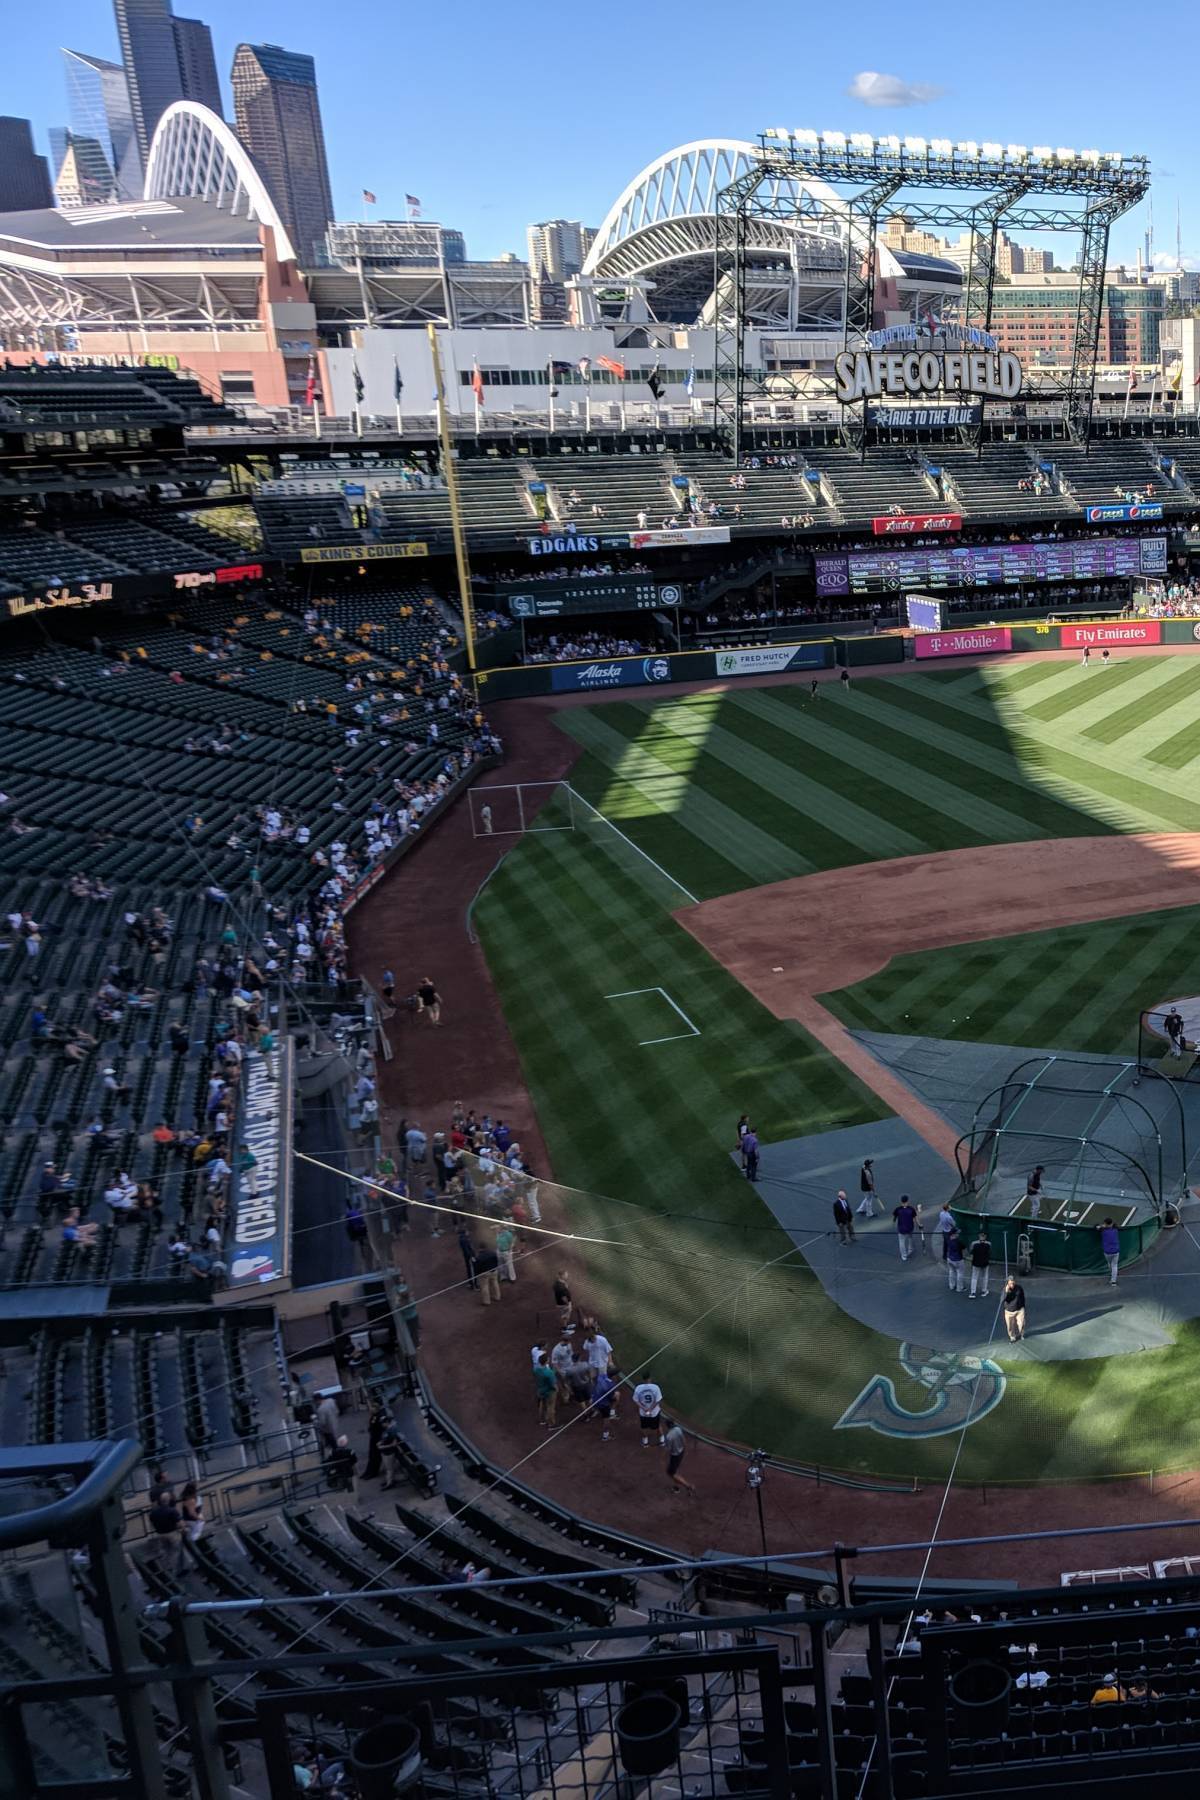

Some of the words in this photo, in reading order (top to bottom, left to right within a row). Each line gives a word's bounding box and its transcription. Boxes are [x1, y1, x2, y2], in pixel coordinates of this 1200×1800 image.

[836, 352, 940, 401] SAFECO
[944, 352, 1022, 398] FIELD
[889, 410, 914, 425] TRUE
[915, 409, 928, 425] TO
[929, 408, 948, 424] THE
[949, 407, 973, 423] BLUE
[1102, 509, 1125, 520] pepsi
[1141, 507, 1163, 518] pepsi
[530, 537, 598, 555] EDGAR'S
[1142, 540, 1164, 551] BUILT
[320, 547, 364, 560] KING'S
[367, 545, 409, 558] COURT
[816, 559, 847, 567] EMERALD
[1143, 561, 1165, 569] TOUGH
[1076, 628, 1095, 641] Fly
[1097, 627, 1146, 640] Emirates
[740, 655, 761, 663] FRED
[763, 653, 790, 661] HUTCH
[577, 664, 622, 680] Alaska
[581, 678, 620, 687] AIRLINES
[236, 1196, 276, 1243] FIELD
[644, 1394, 653, 1404] 9
